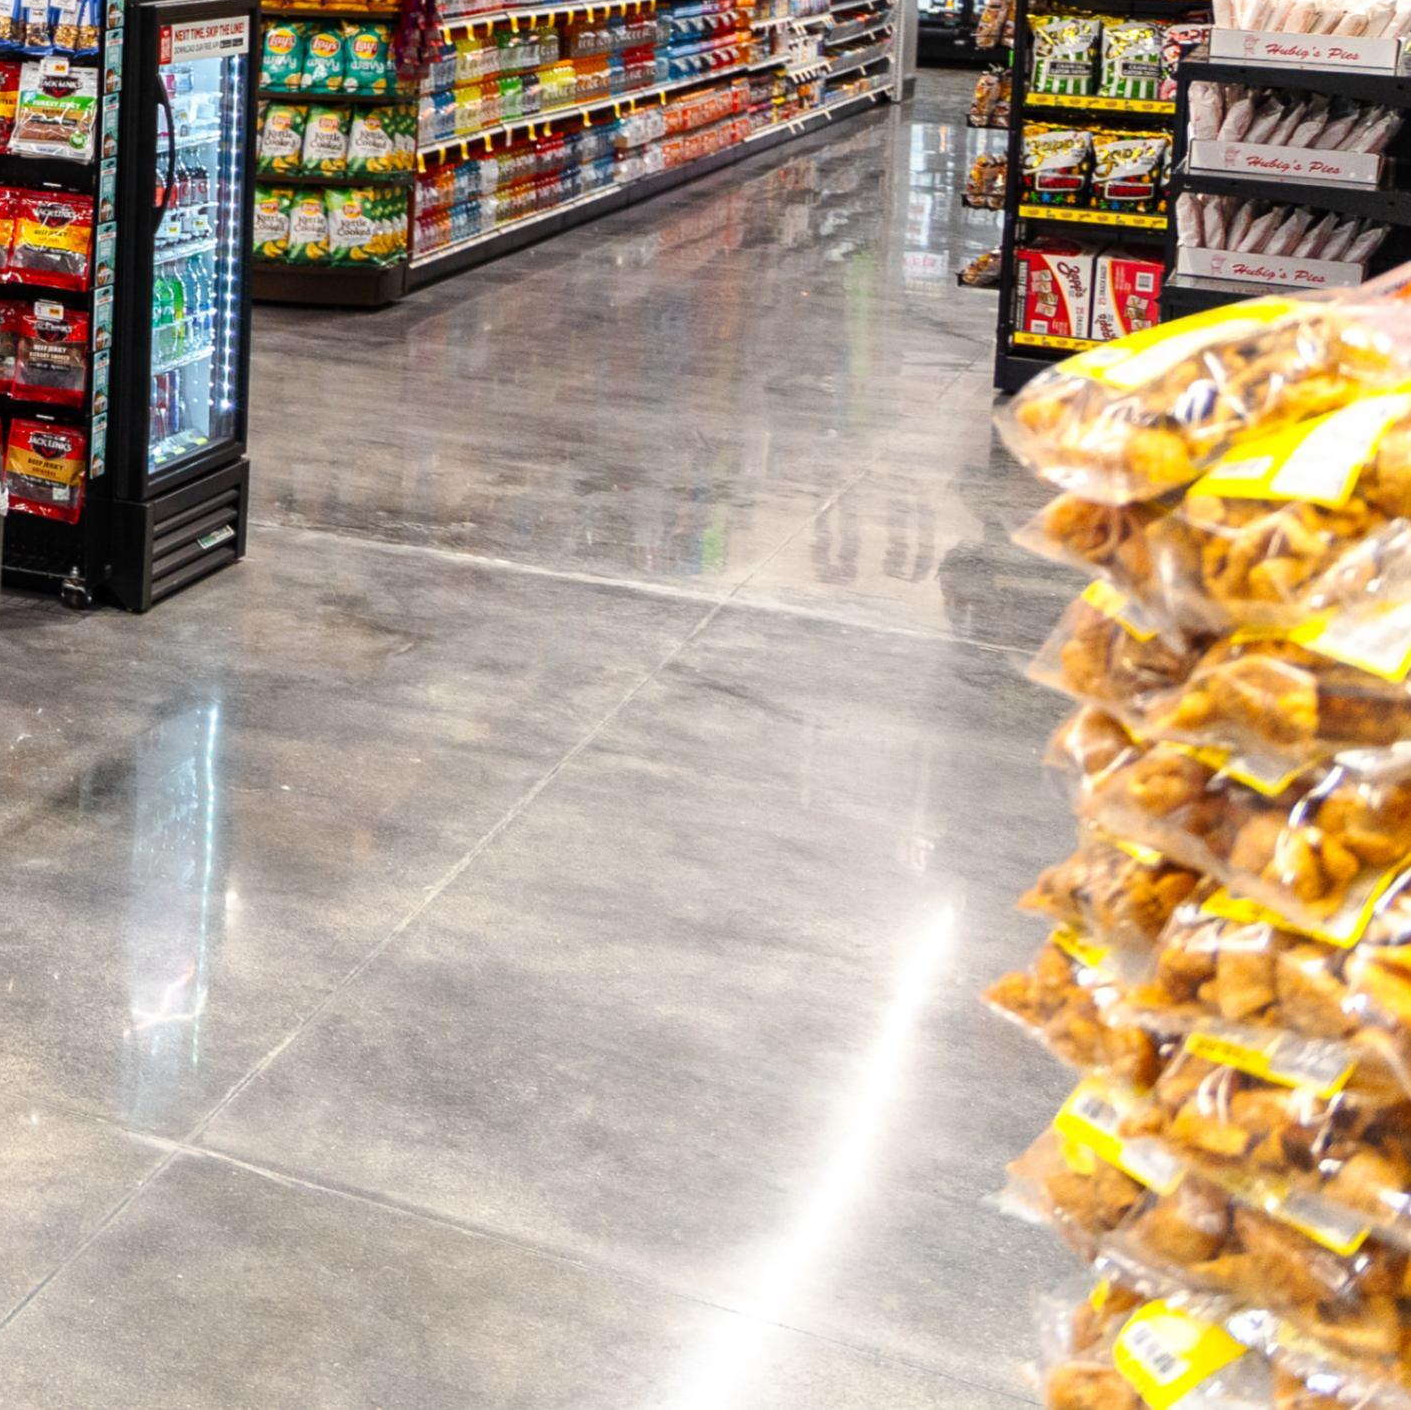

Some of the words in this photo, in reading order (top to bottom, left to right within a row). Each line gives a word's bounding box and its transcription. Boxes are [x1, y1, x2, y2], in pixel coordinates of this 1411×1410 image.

[1264, 41, 1325, 61] Hubig's
[1328, 43, 1360, 61] Pies
[1233, 261, 1288, 282] Hubig's
[1290, 264, 1327, 284] Pies
